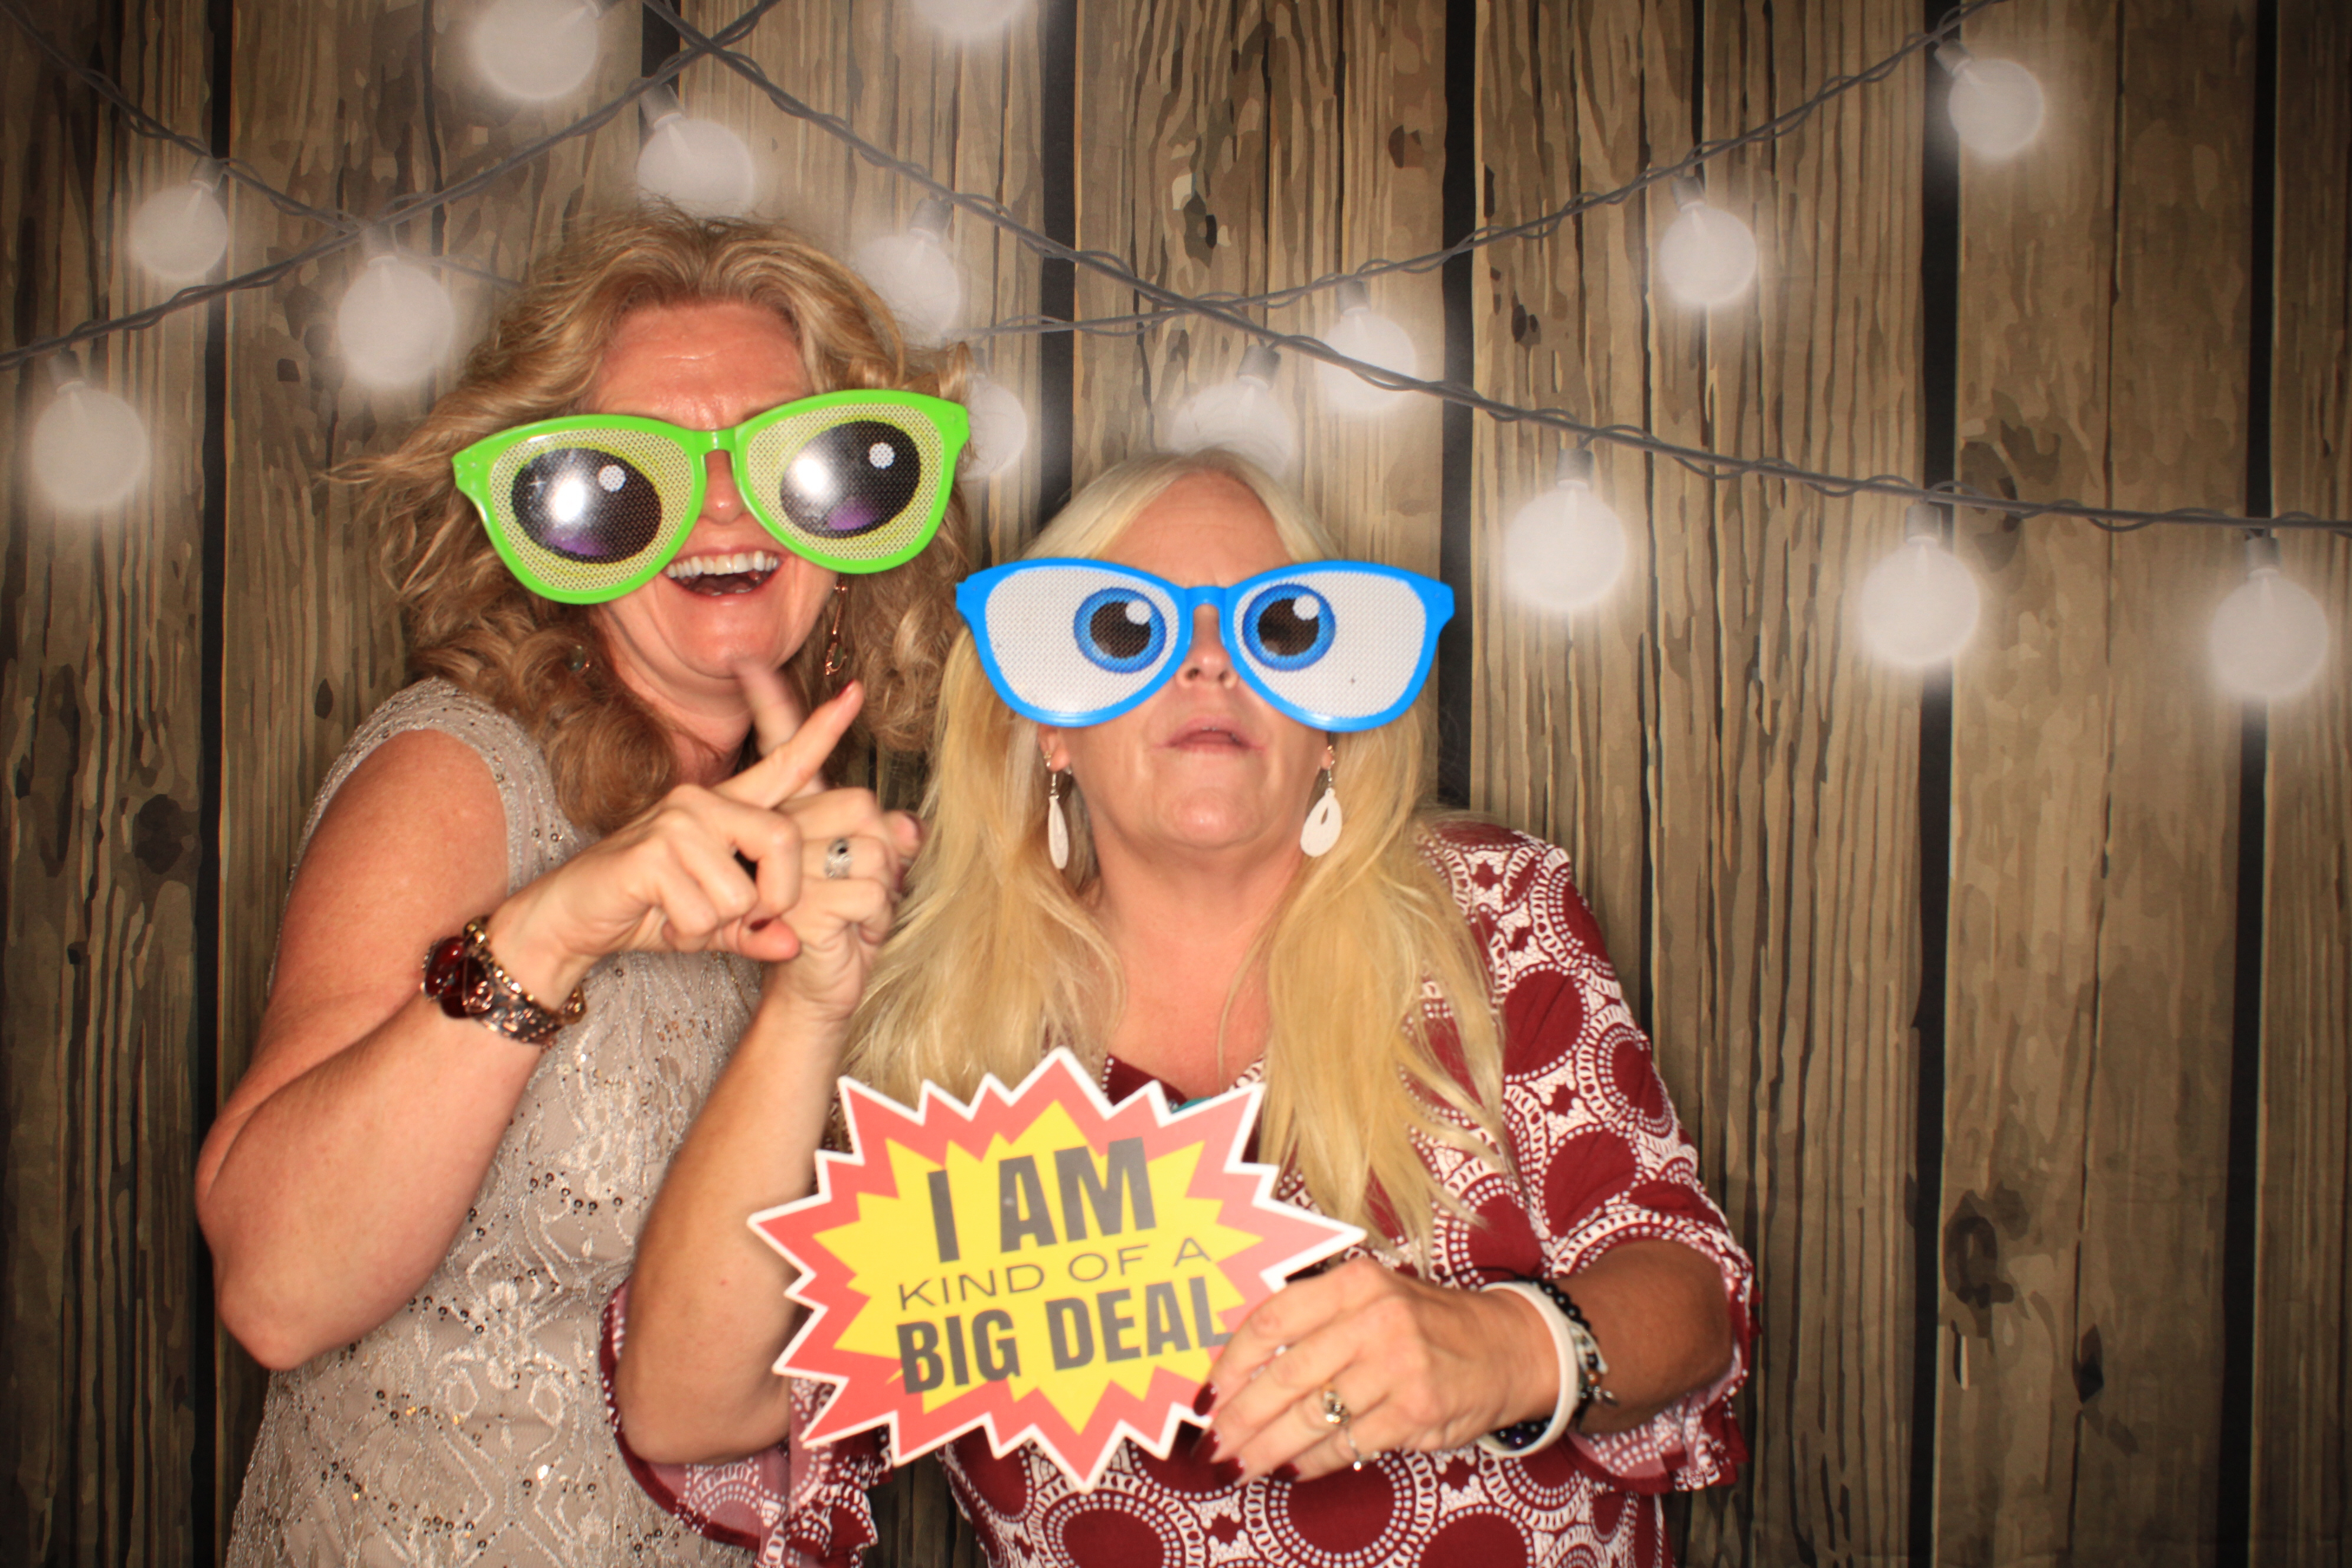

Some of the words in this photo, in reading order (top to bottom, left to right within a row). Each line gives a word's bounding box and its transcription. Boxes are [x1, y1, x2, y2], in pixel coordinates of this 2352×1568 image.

[927, 1171, 959, 1262] I
[999, 1137, 1155, 1253] AM
[899, 1263, 1044, 1309] KIND
[1069, 1243, 1150, 1281] OF
[1174, 1237, 1211, 1266] A
[896, 1309, 1020, 1394] BIG
[1045, 1275, 1234, 1371] DEAL
